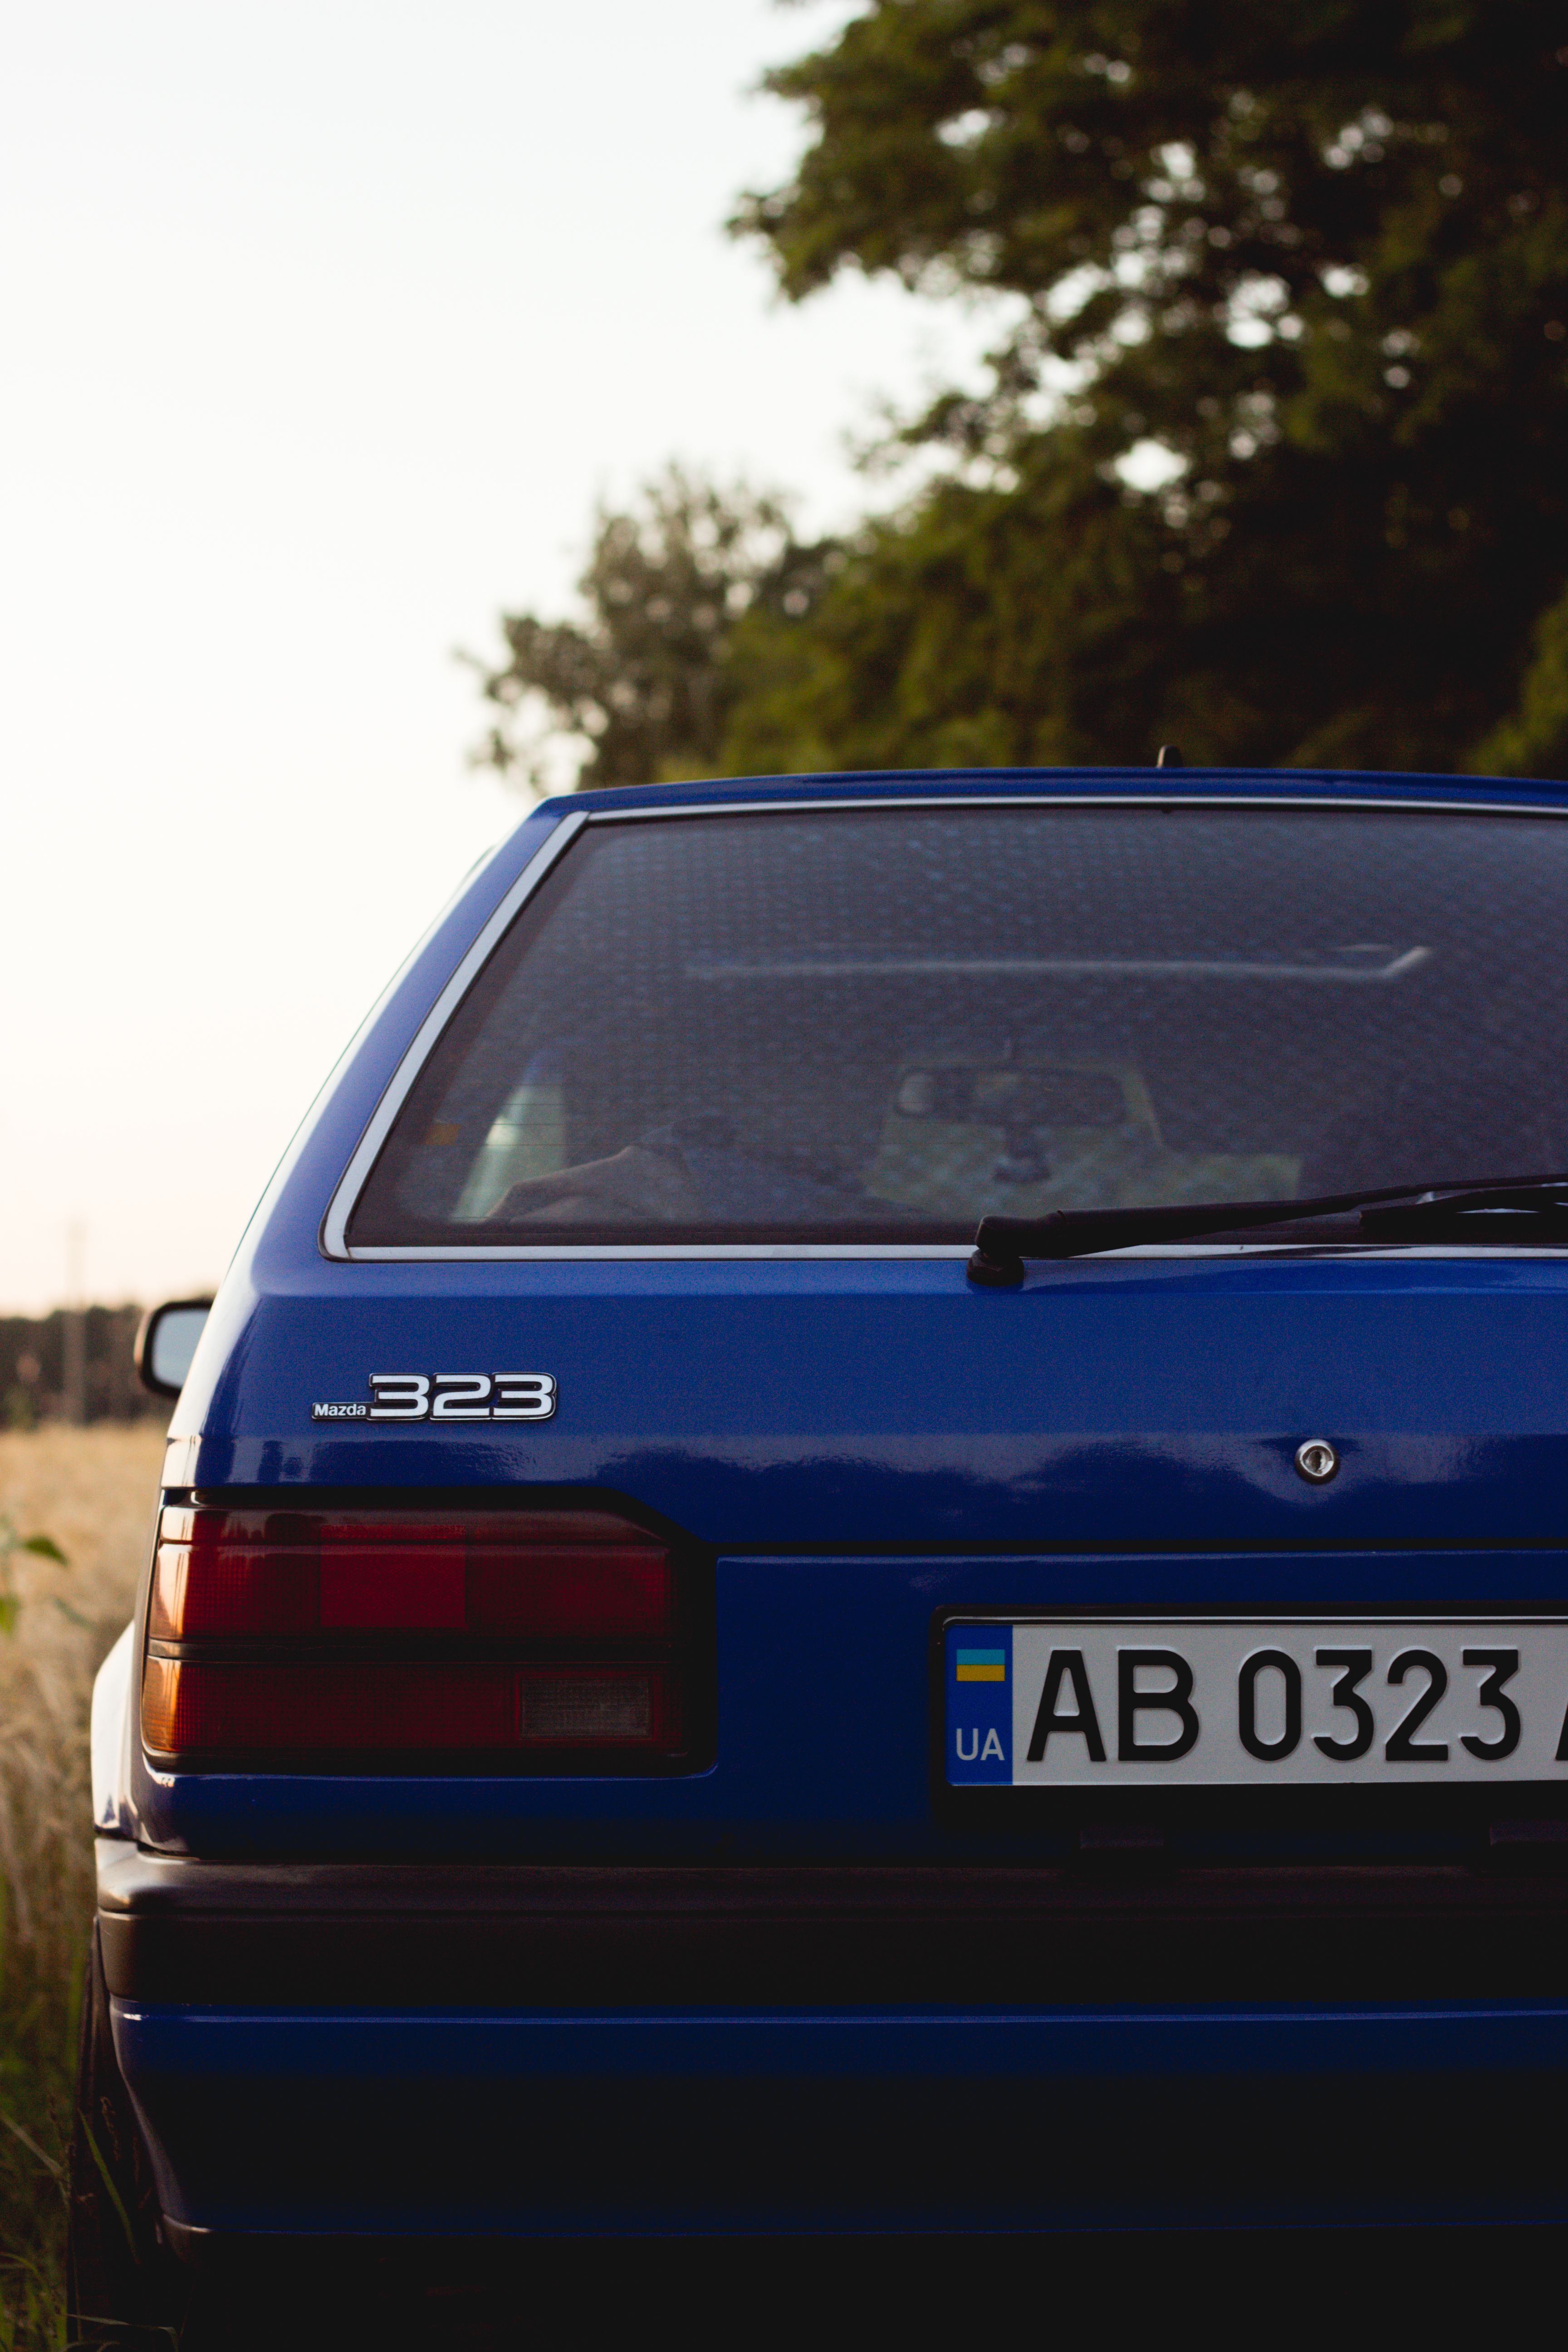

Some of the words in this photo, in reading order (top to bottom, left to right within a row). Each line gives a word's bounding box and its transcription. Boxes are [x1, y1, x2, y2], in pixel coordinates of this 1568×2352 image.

[314, 1403, 366, 1416] Mazda
[370, 1374, 554, 1416] 323
[1027, 1649, 1200, 1762] AB
[1238, 1649, 1521, 1762] 0323
[956, 1728, 1005, 1761] UA
